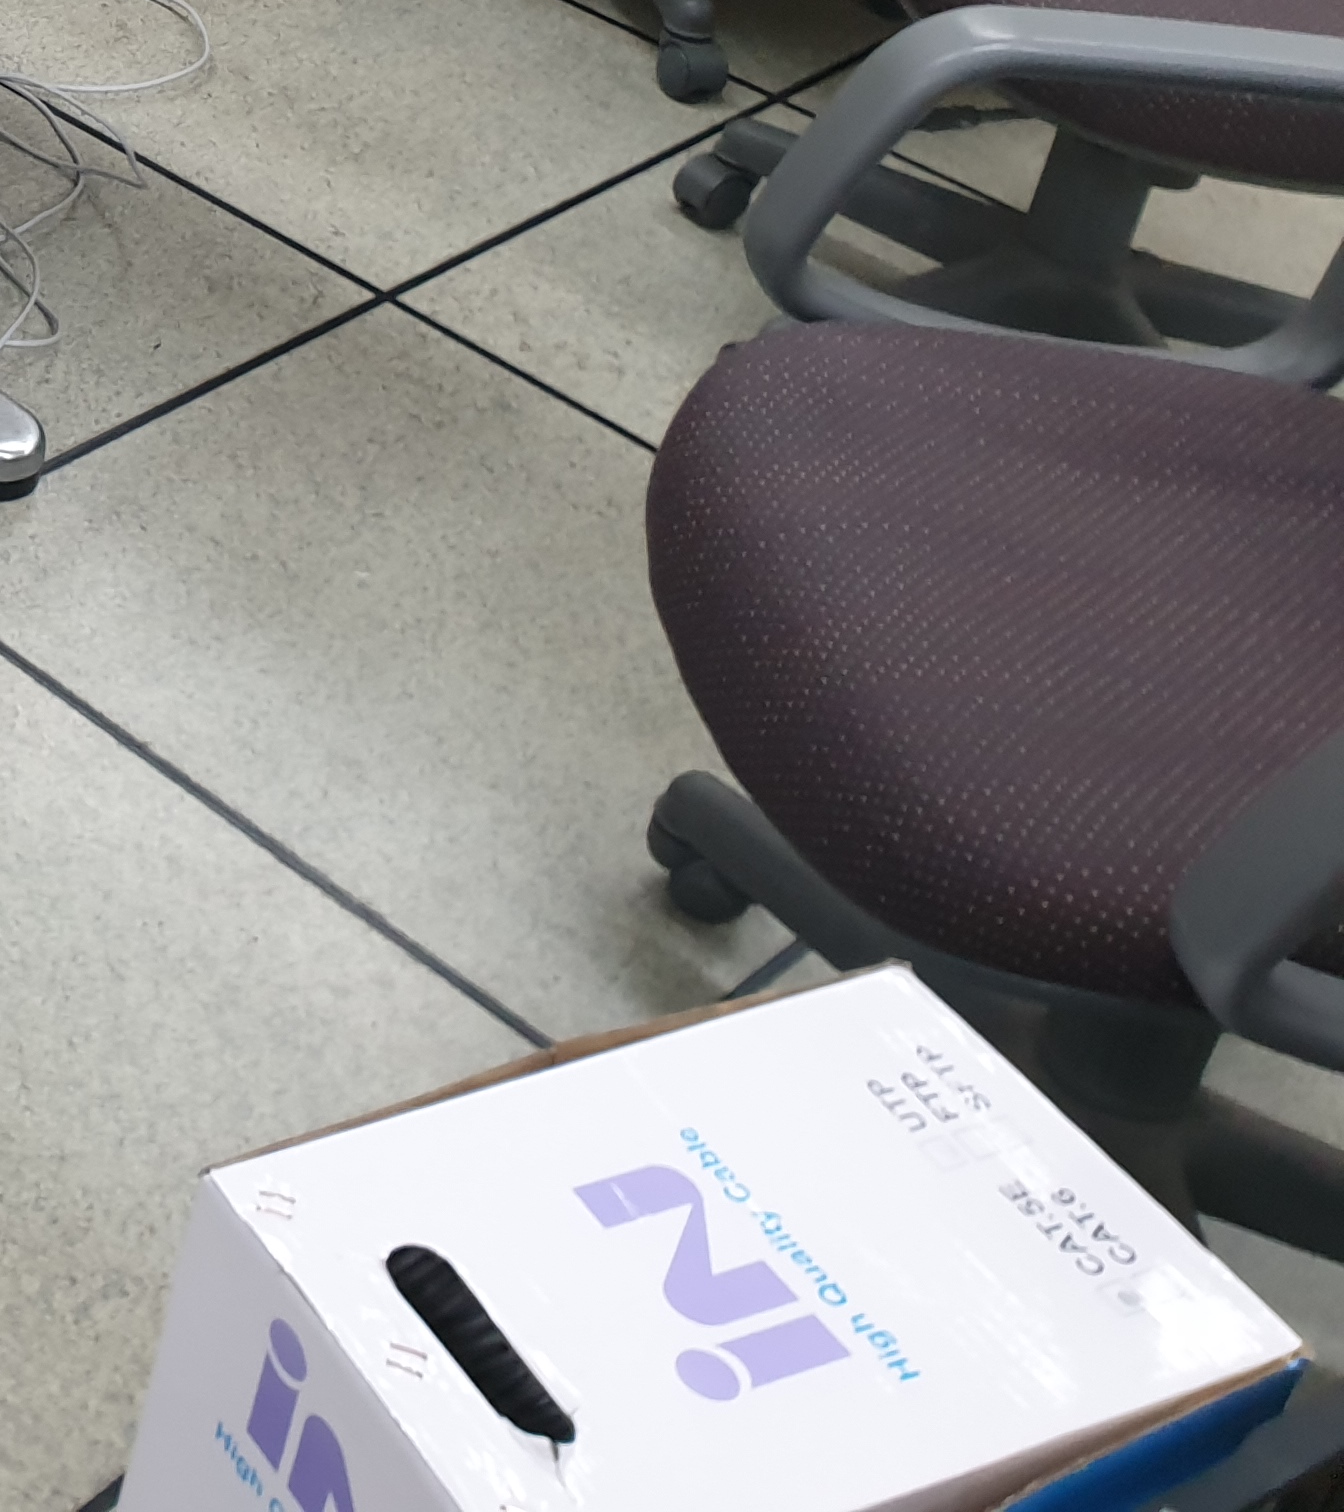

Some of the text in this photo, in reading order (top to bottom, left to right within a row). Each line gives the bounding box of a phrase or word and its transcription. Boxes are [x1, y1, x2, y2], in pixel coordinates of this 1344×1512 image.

[866, 1079, 927, 1132] UTP
[900, 1072, 960, 1123] FTP
[679, 1126, 920, 1382] High Quality Cable
[998, 1179, 1106, 1276] CAT.5E
[215, 1421, 264, 1497] High
